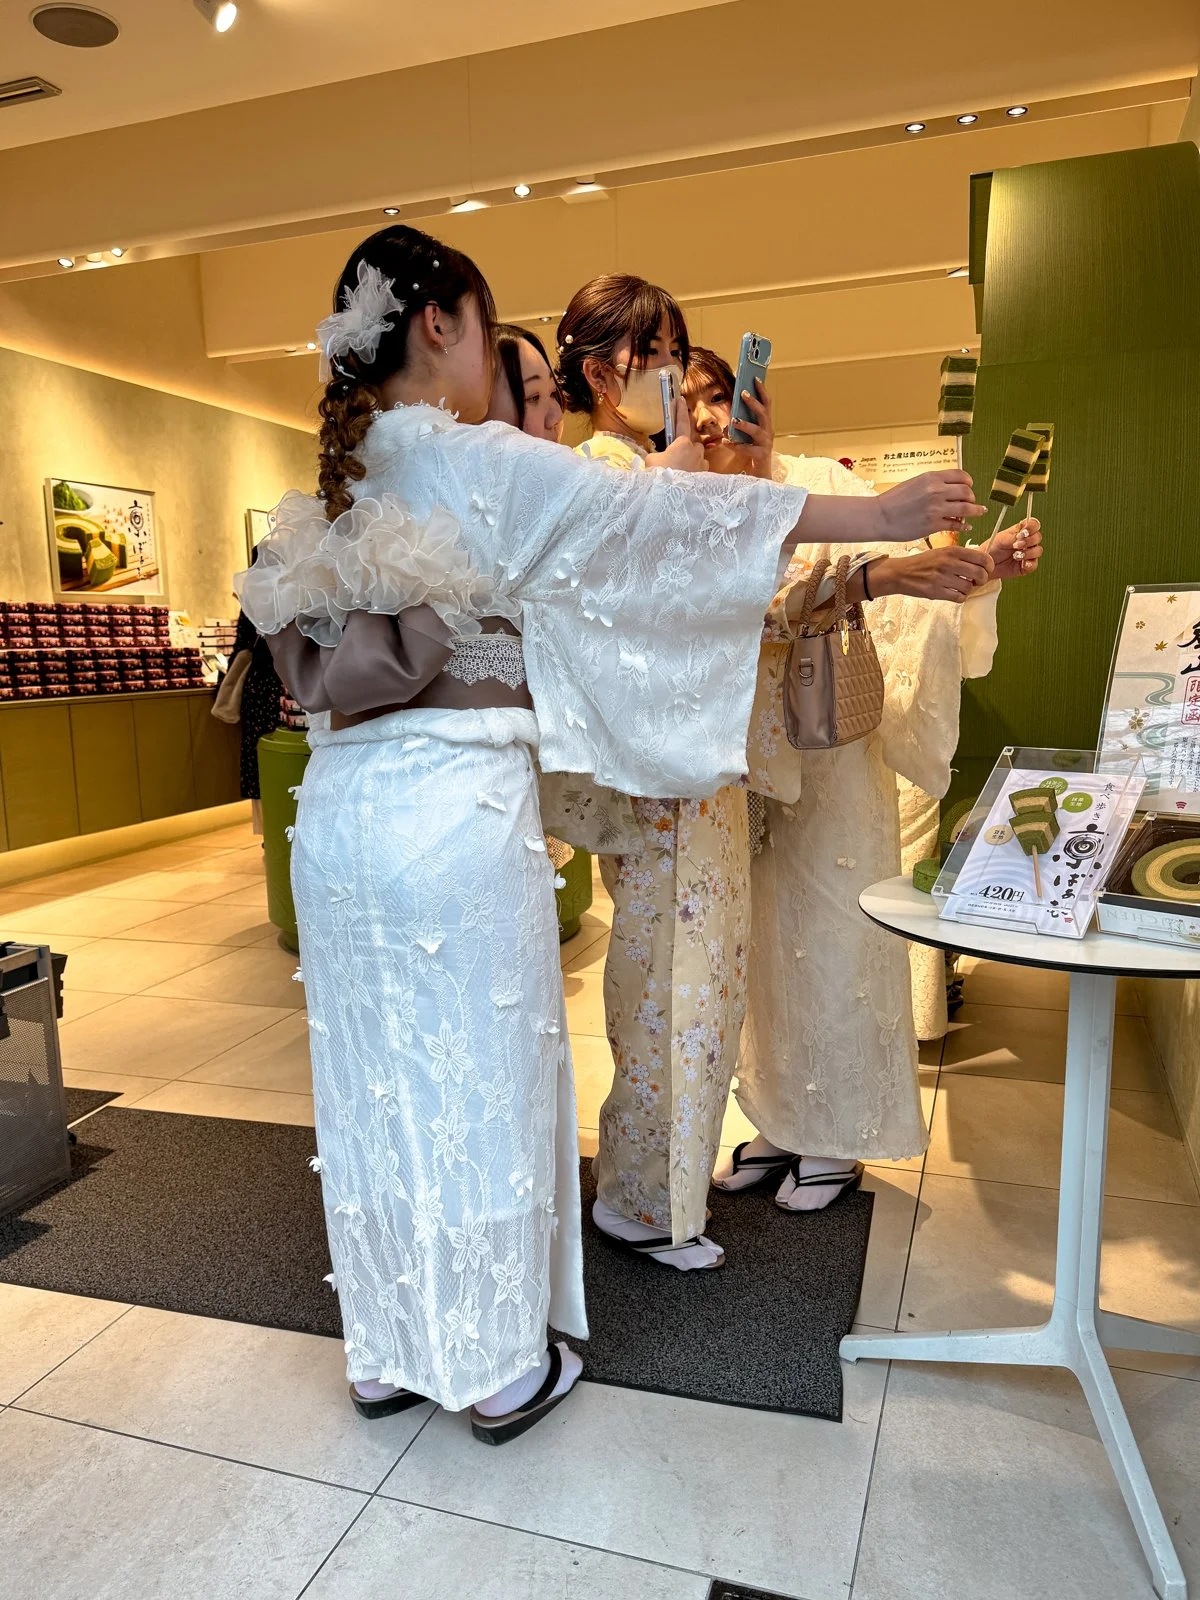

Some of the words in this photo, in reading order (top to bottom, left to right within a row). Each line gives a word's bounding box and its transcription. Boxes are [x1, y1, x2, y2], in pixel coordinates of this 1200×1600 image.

[884, 448, 957, 460] お土産は奥のレジへどう
[1092, 782, 1116, 821] 食べ歩き
[979, 884, 1025, 902] 420円
